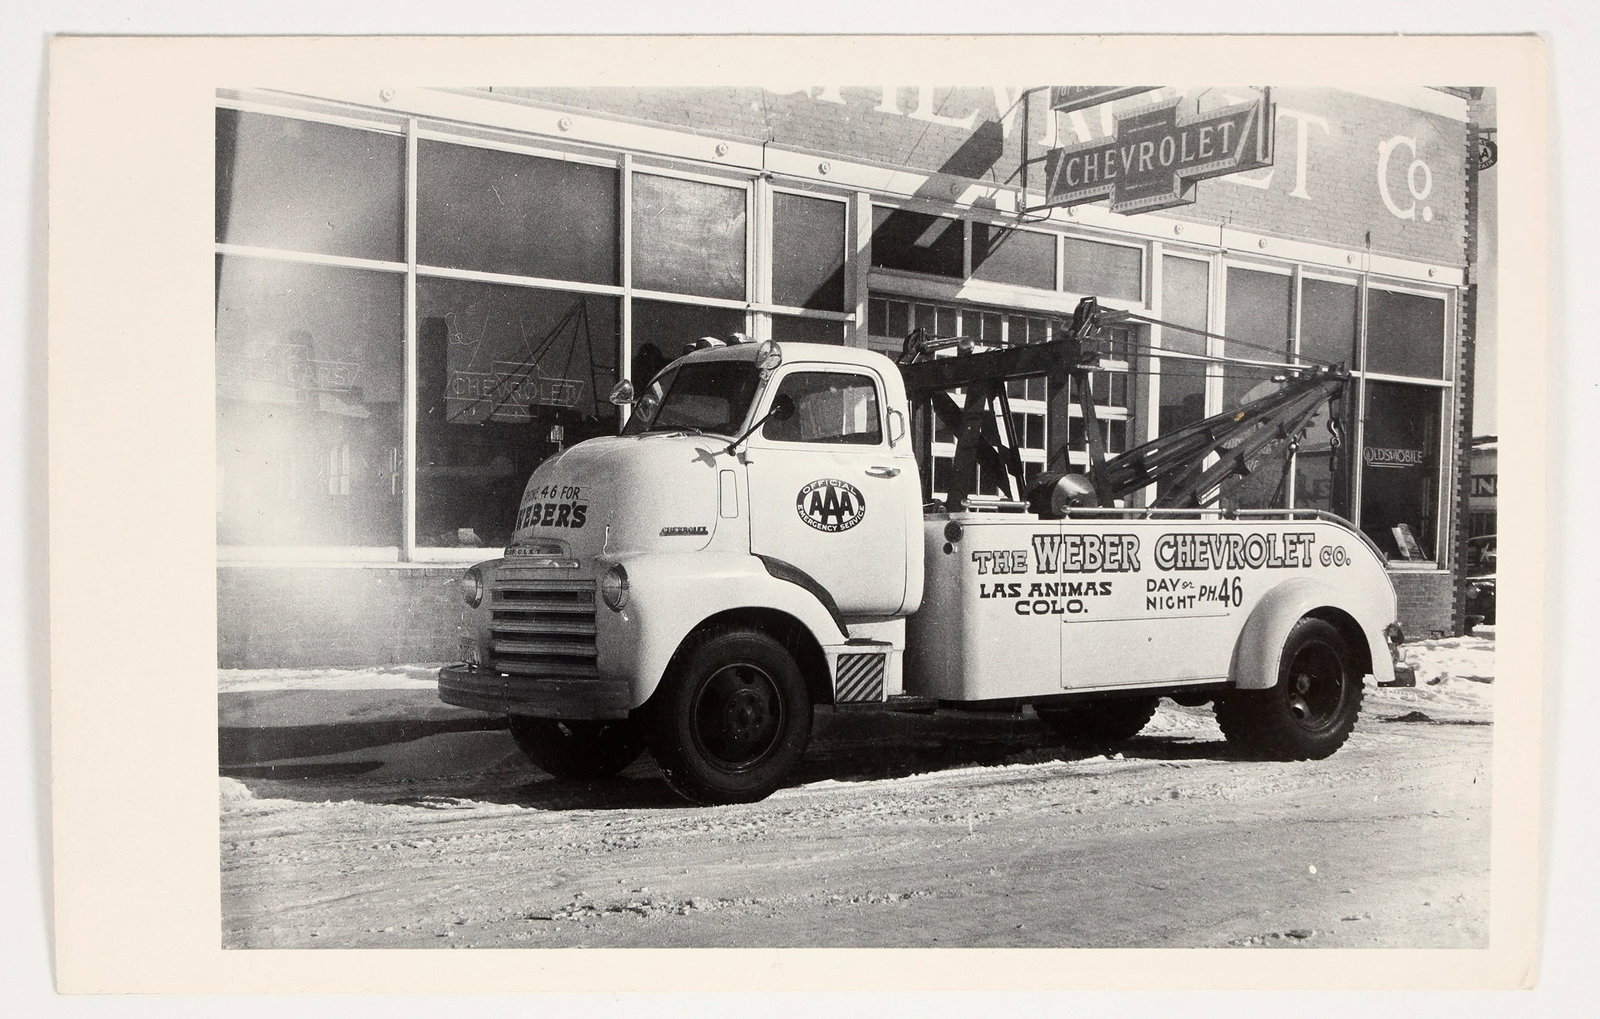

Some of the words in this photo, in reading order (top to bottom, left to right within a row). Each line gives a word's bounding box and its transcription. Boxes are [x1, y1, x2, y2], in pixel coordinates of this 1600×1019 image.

[1066, 121, 1236, 187] CHEVROLET
[1364, 446, 1423, 464] OLDSMOBILE
[541, 485, 557, 499] 46
[560, 486, 580, 500] FOR
[803, 479, 857, 495] OFFICIAL
[809, 486, 854, 525] AAA
[797, 504, 838, 531] EMERGENCY
[839, 505, 864, 531] SERVICE
[972, 550, 1027, 575] THE
[1032, 534, 1140, 574] WEBER
[1154, 533, 1315, 571] CHEVROLET
[1319, 545, 1351, 567] CO.
[980, 583, 1021, 598] LAS
[1028, 582, 1112, 597] ANIMAS
[1146, 579, 1180, 592] DAY
[1181, 581, 1195, 589] or
[1015, 599, 1088, 615] COLO.
[1146, 595, 1196, 610] NIGHT
